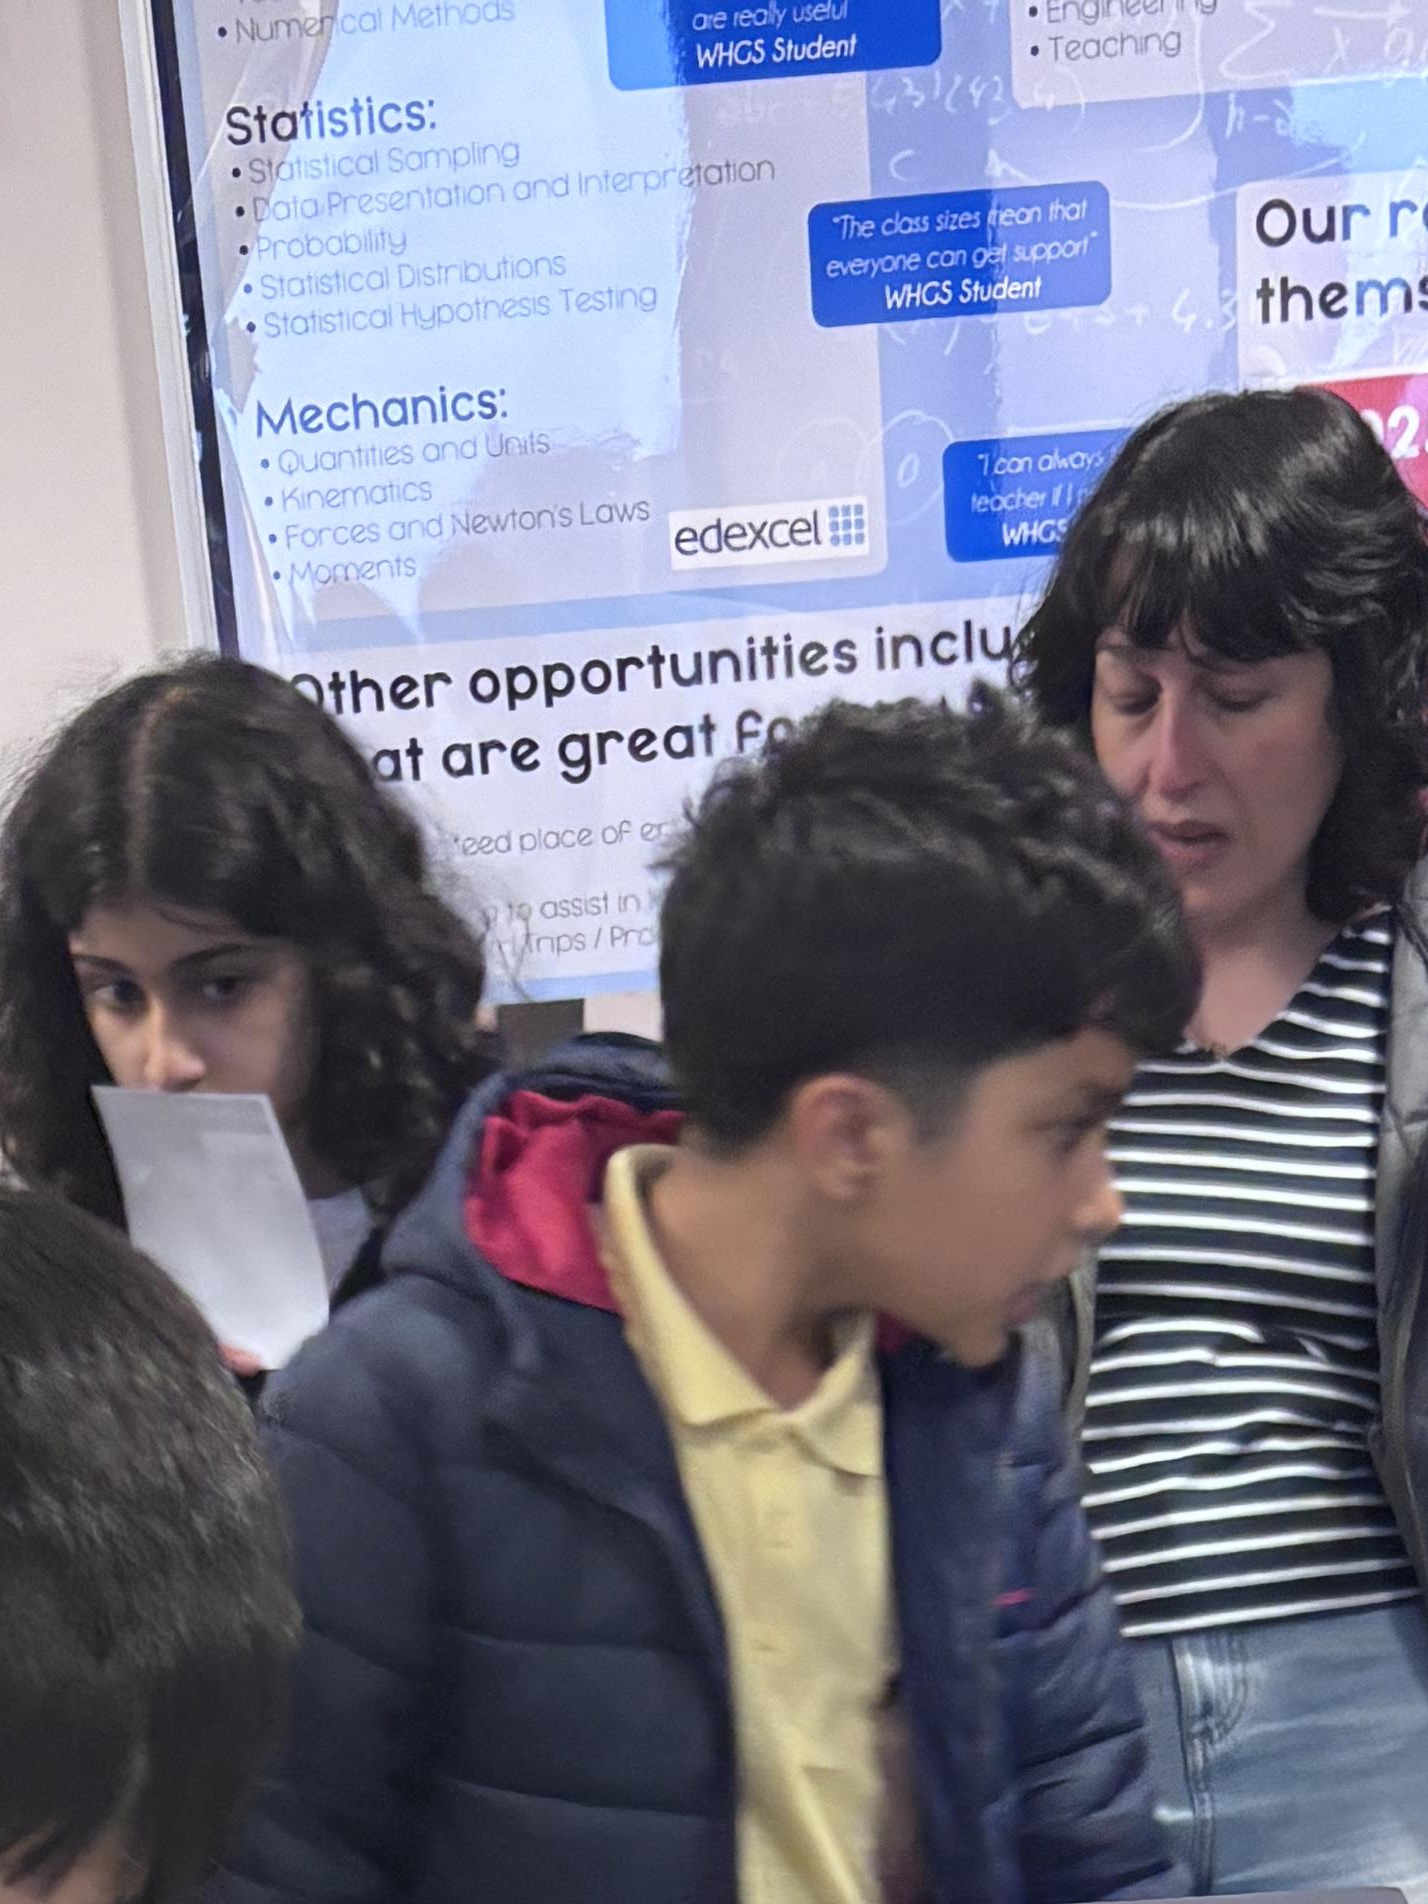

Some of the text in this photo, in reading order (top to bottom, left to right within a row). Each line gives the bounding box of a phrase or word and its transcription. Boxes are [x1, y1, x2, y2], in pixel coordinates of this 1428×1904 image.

[236, 0, 515, 43] Numerical Methods
[692, 10, 728, 31] are
[733, 4, 785, 31] really
[696, 34, 857, 68] WHGS Student
[1048, 31, 1182, 61] Teaching
[226, 97, 437, 146] Statistics:
[248, 139, 521, 185] Statistical Sampling
[253, 158, 775, 223] Data Presentation and Interpretation
[880, 210, 930, 235] class
[936, 209, 980, 232] sizes
[986, 206, 1042, 229] mean
[1047, 199, 1088, 224] that
[1254, 192, 1370, 247] Our
[256, 227, 406, 262] Probability
[826, 249, 922, 280] everyone
[926, 246, 968, 270] can
[971, 241, 1008, 273] get
[259, 252, 566, 301] Statistical Distributions
[884, 275, 1042, 310] WHGS Student
[263, 283, 657, 338] Statistical Hypothesis Testing
[256, 386, 509, 439] Mechanics:
[278, 428, 551, 475] Quantities and Units
[994, 455, 1033, 475] can
[1037, 448, 1105, 473] always
[280, 479, 434, 512] Kinematics
[971, 486, 1047, 513] teacher
[284, 518, 381, 551] Forces
[388, 512, 444, 542] and
[578, 498, 652, 527] Laws
[674, 510, 822, 558] edexcel
[288, 555, 418, 587] Moments
[287, 620, 1013, 718] Other opportunities inclu
[374, 707, 794, 785] at are great fo
[520, 826, 593, 856] place
[601, 820, 632, 846] of
[540, 893, 608, 919] assist
